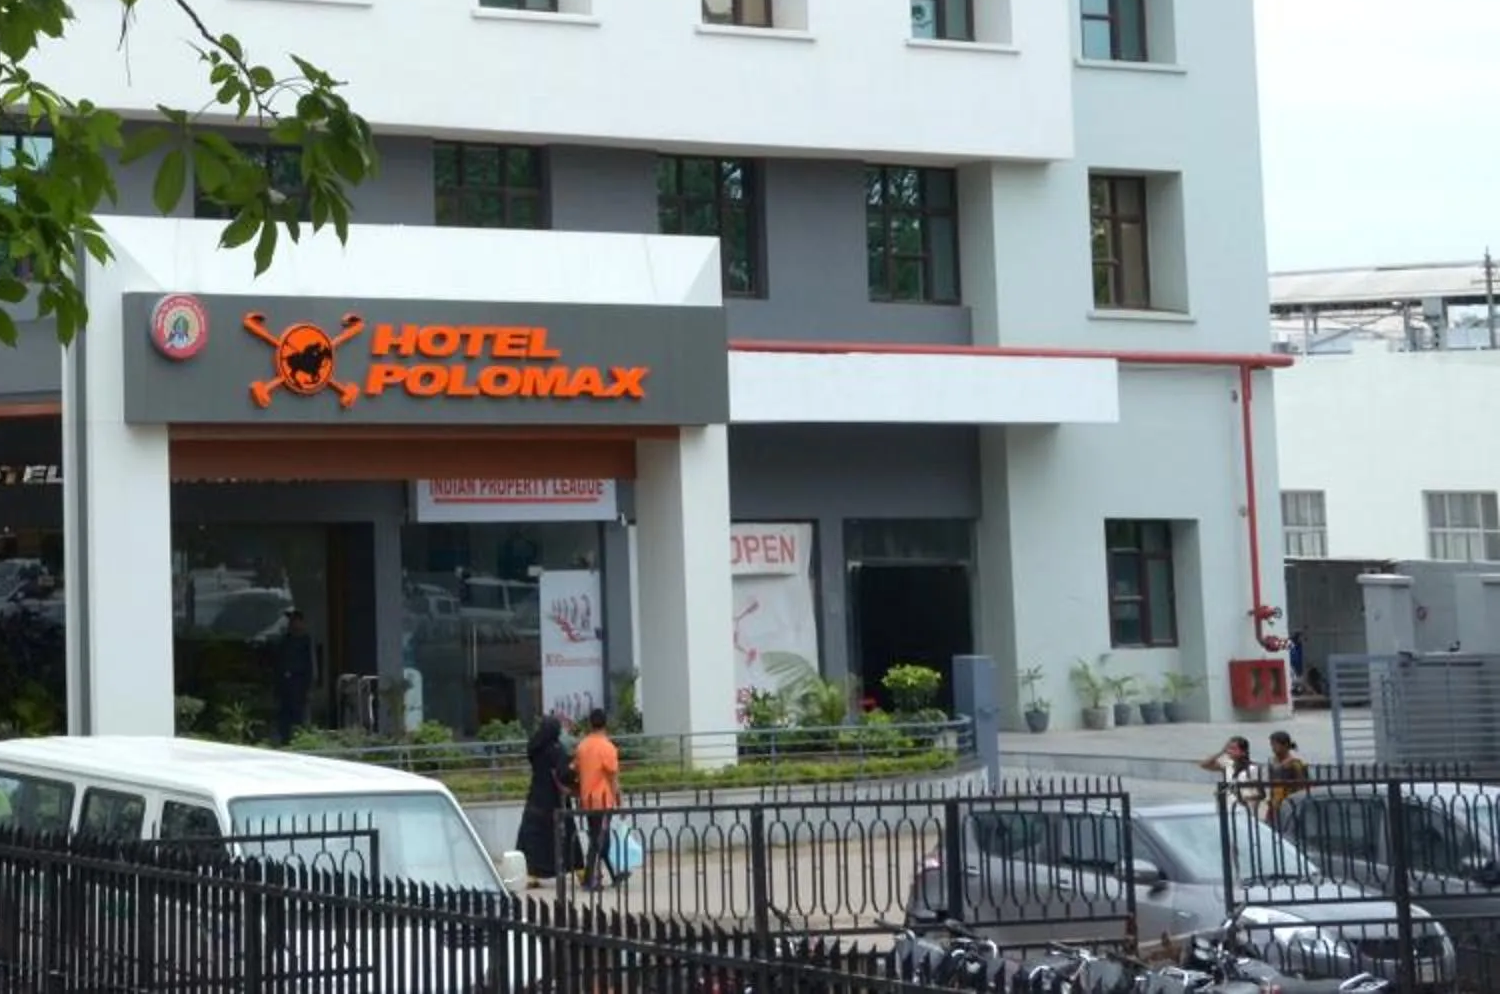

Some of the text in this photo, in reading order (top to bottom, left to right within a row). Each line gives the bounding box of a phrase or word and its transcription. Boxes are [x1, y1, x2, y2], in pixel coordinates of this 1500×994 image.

[371, 323, 561, 359] HOTEL
[365, 363, 649, 399] POLOMAX
[429, 477, 604, 496] INDIAN PROPERTY LEAGUE
